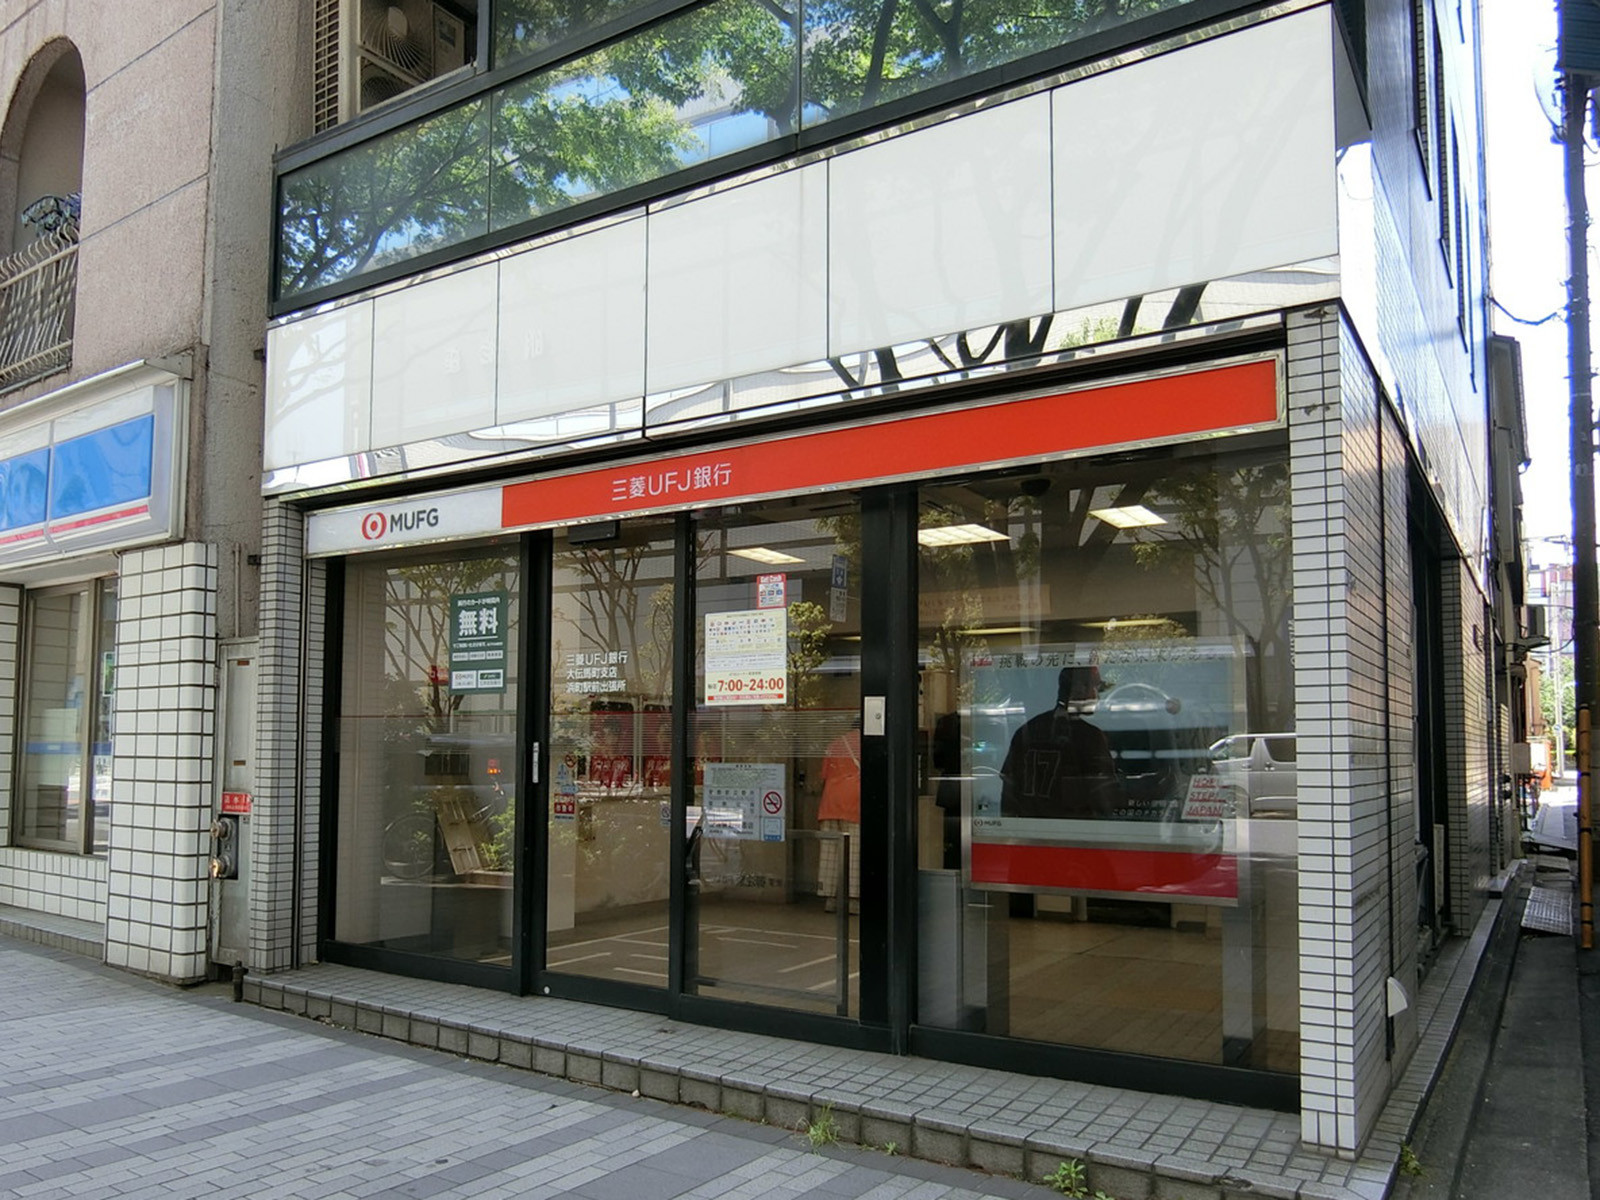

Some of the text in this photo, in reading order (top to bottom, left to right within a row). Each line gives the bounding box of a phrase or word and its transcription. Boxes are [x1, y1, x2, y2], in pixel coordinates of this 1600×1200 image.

[612, 463, 732, 501] 三菱UFJ銀行
[390, 508, 439, 532] MUFG
[458, 607, 499, 636] 無料
[566, 650, 628, 666] 三菱UFJ銀行
[566, 666, 618, 680] 大伝馬町支店
[1022, 748, 1061, 799] 17
